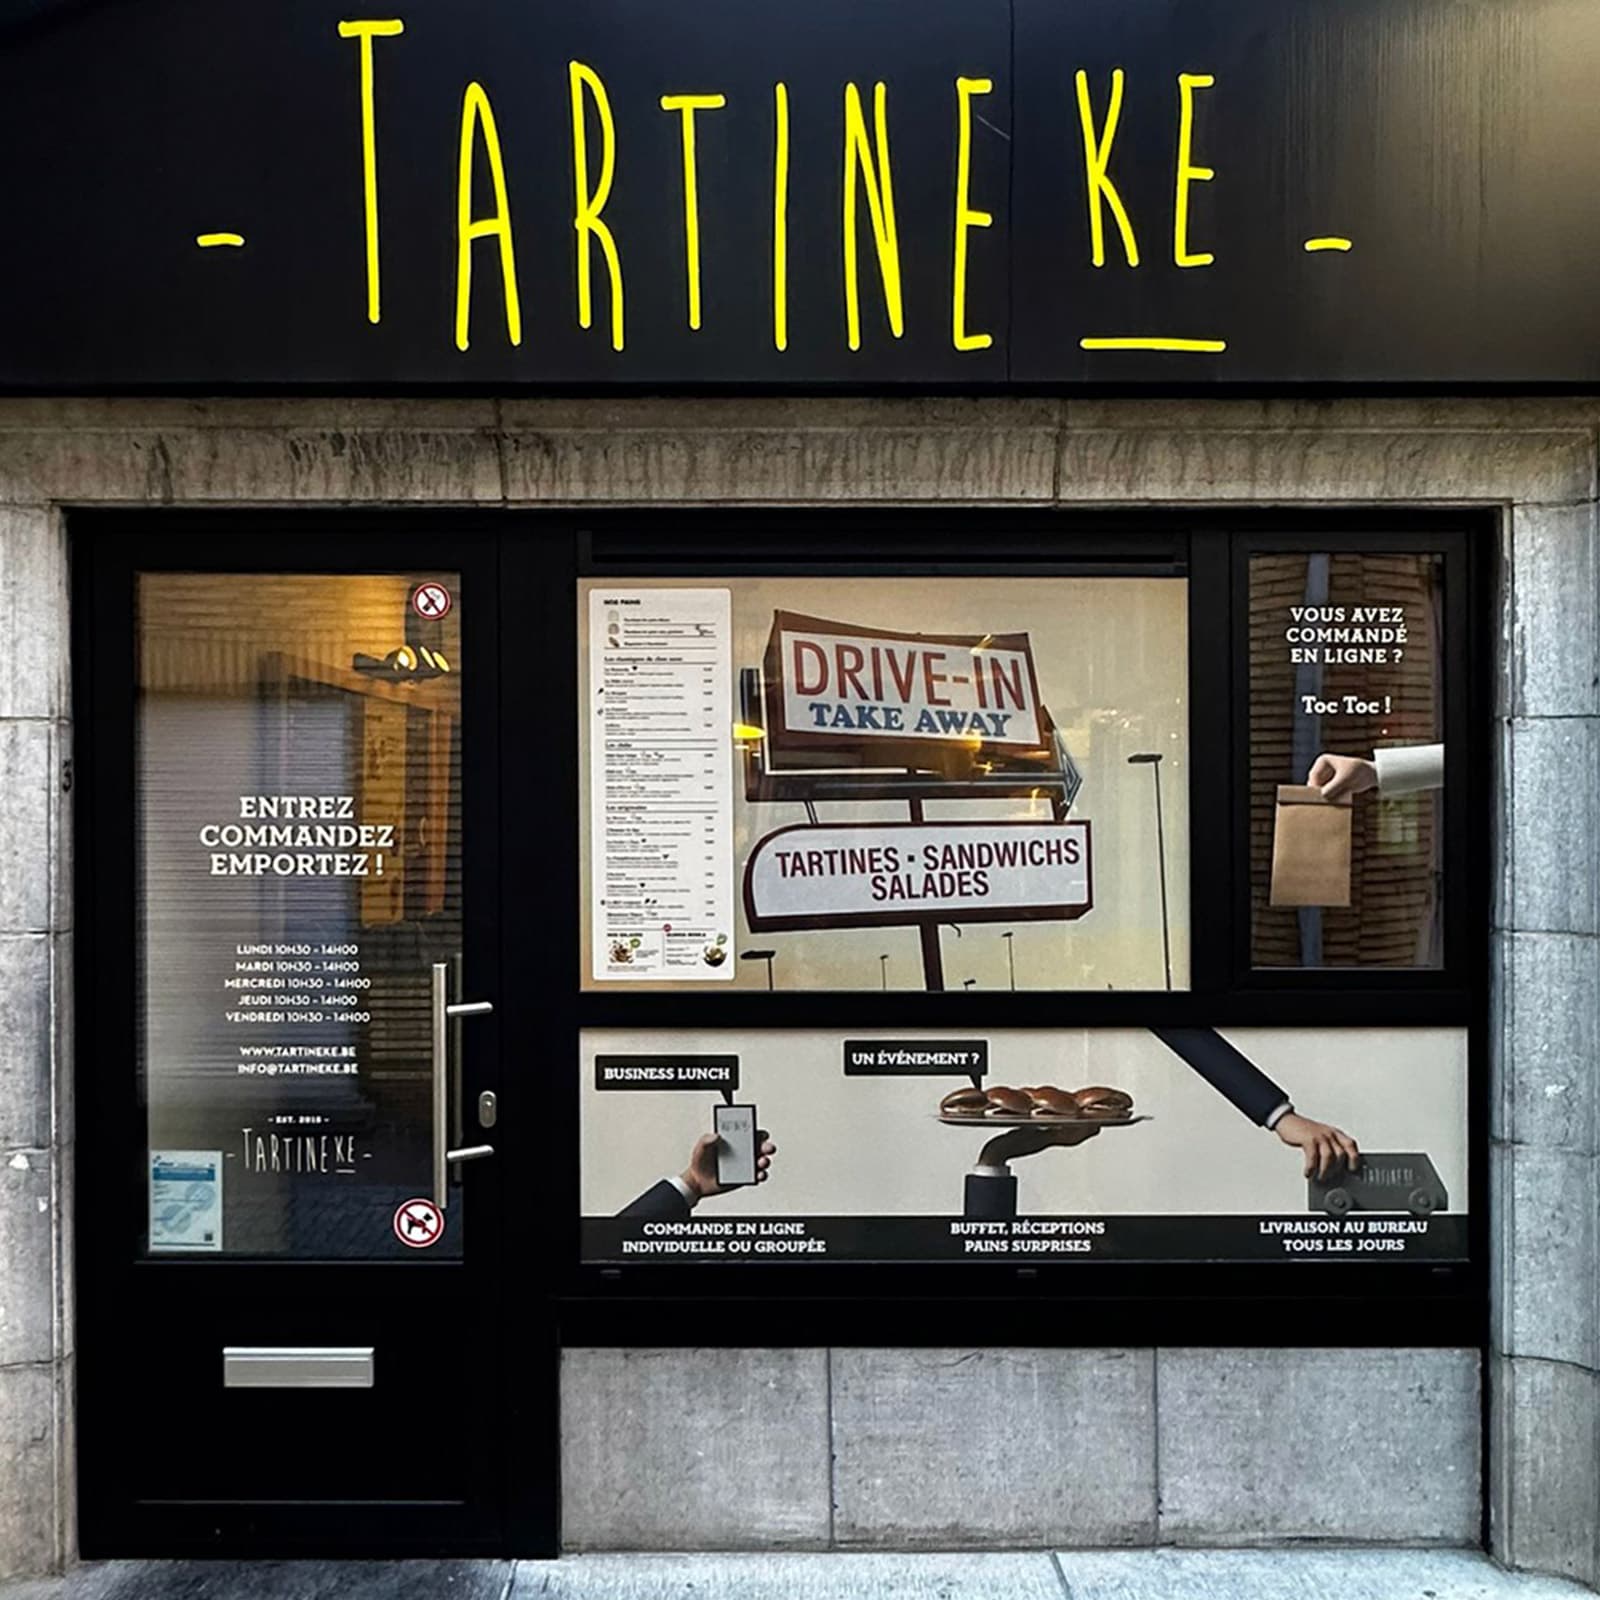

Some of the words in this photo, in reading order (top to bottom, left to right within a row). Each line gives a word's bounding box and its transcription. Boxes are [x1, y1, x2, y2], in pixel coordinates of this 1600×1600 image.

[1290, 607, 1345, 622] VOUS
[1351, 608, 1403, 622] AVEZ
[1286, 624, 1408, 643] COMMANDÉ
[1291, 648, 1318, 663] EN
[1324, 648, 1387, 663] LIGNE
[793, 639, 1027, 712] DRIVE-IN
[1301, 696, 1339, 714] Toc
[1343, 696, 1380, 714] Toc
[809, 702, 904, 732] TAKE
[915, 709, 1012, 738] AWAY
[239, 797, 354, 818] ENTREZ
[200, 825, 394, 847] COMMANDEZ
[210, 853, 369, 875] EMPORTEZ
[775, 847, 900, 879] TARTINES
[923, 838, 1081, 871] SANDWICHS
[872, 871, 990, 901] SALADES
[236, 944, 272, 955] LUNDI
[275, 944, 311, 955] 10H30
[321, 944, 358, 955] 14H00
[235, 961, 273, 972] MARDI
[276, 961, 312, 972] 10H30
[322, 961, 360, 972] 14H00
[224, 978, 285, 989] MERCREDI
[288, 978, 323, 989] 10H30
[334, 978, 371, 989] 14H00
[238, 995, 272, 1006] JEUDI
[274, 995, 310, 1006] 10H30
[320, 995, 358, 1006] 14H00
[225, 1012, 285, 1022] VENDREDI
[287, 1012, 323, 1022] 10H30
[333, 1012, 371, 1022] 14H00
[239, 1046, 357, 1057] WWW.TARTINEKE.BE
[852, 1053, 874, 1065] UN
[877, 1050, 968, 1065] ÉVÉNEMENT
[238, 1063, 359, 1075] INFO@TARTINEKE.BE
[604, 1067, 674, 1081] BUSINESS
[677, 1067, 731, 1081] LUNCH
[643, 1223, 733, 1236] COMMANDE
[736, 1223, 756, 1236] EN
[759, 1223, 805, 1236] LIGNE
[950, 1222, 1008, 1236] BUFFET,
[1010, 1219, 1105, 1235] RÉCEPTIONS
[1259, 1221, 1340, 1234] LIVRAISON
[1342, 1221, 1365, 1234] AU
[1368, 1221, 1428, 1234] BUREAU
[622, 1240, 724, 1253] INDIVIDUELLE
[726, 1240, 751, 1253] OU
[754, 1237, 826, 1253] GROUPÉE
[965, 1240, 1009, 1253] PAINS
[1012, 1240, 1092, 1253] SURPRISES
[1282, 1239, 1324, 1251] TOUS
[1326, 1239, 1354, 1251] LES
[1356, 1239, 1405, 1251] JOURS
